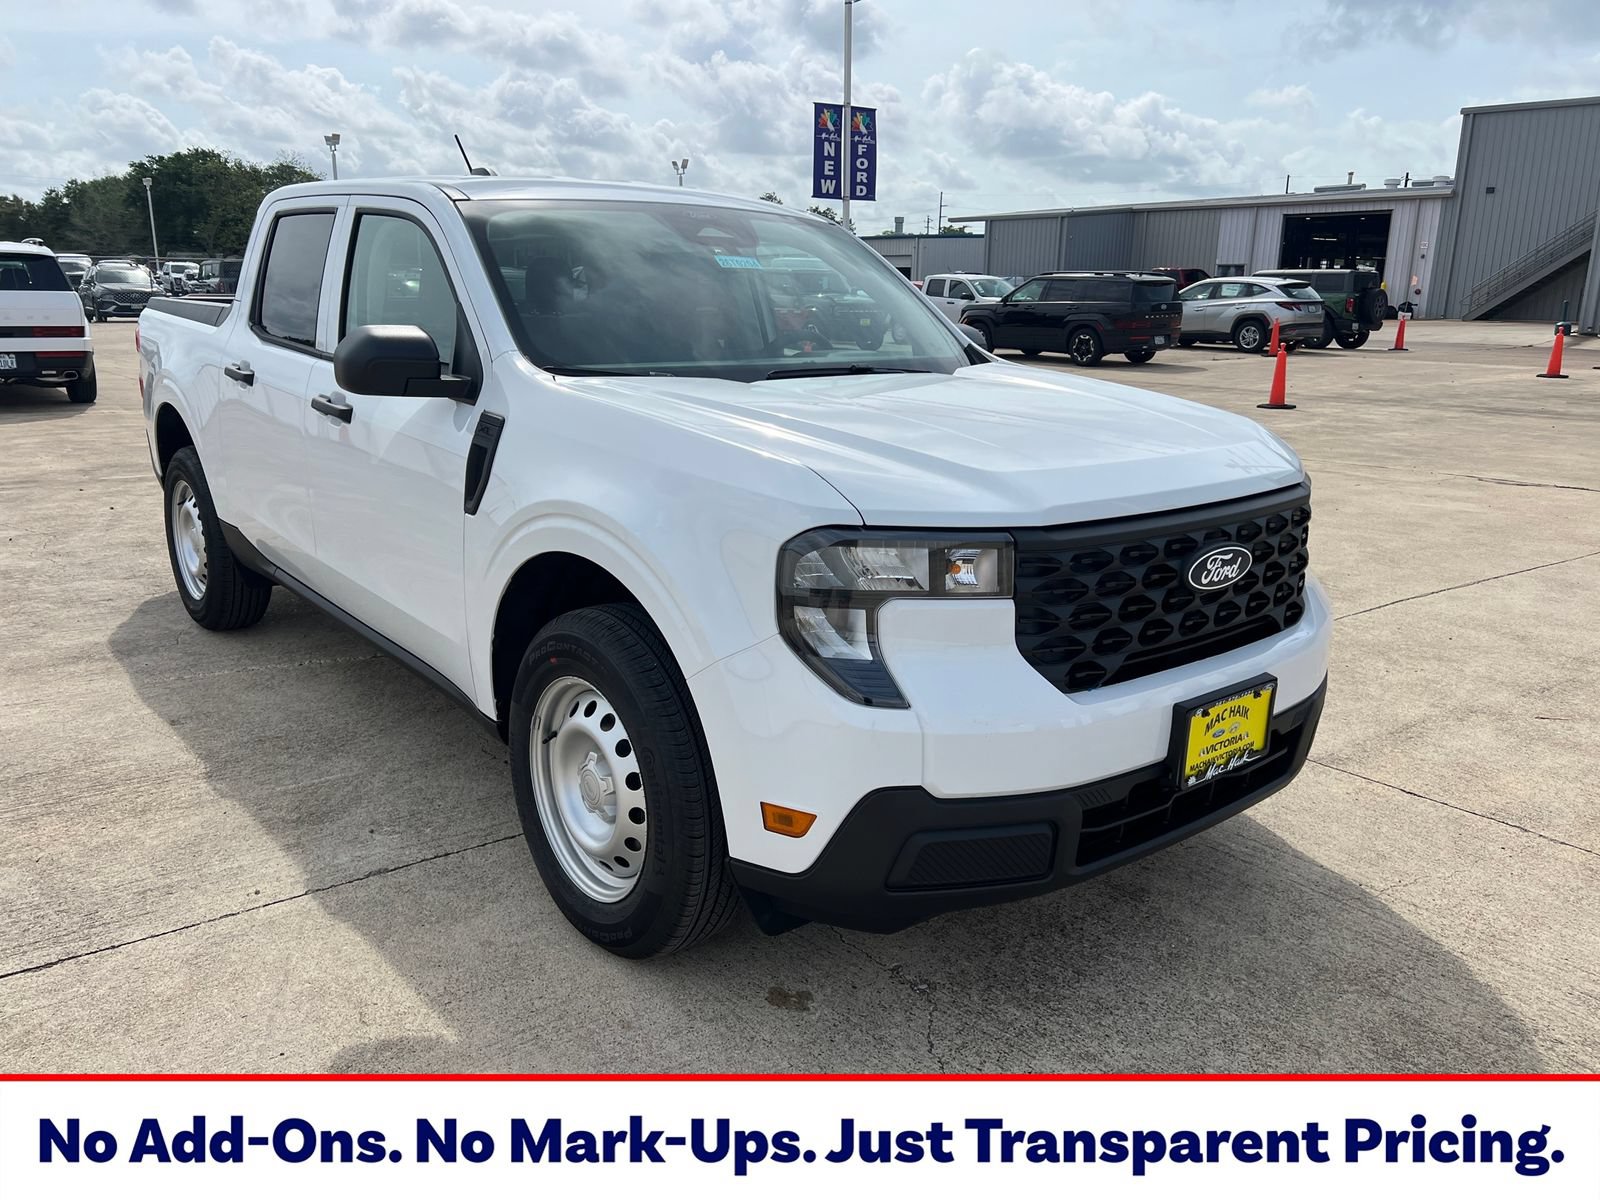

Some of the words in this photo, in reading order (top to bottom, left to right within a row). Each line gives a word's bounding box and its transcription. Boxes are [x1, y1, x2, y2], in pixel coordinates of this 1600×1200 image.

[820, 141, 837, 194] NEW
[855, 144, 869, 196] FORD
[1201, 552, 1242, 585] Ford
[1204, 708, 1228, 736] MAC
[1228, 704, 1250, 720] HAIK
[1203, 733, 1243, 755] VICTORIA
